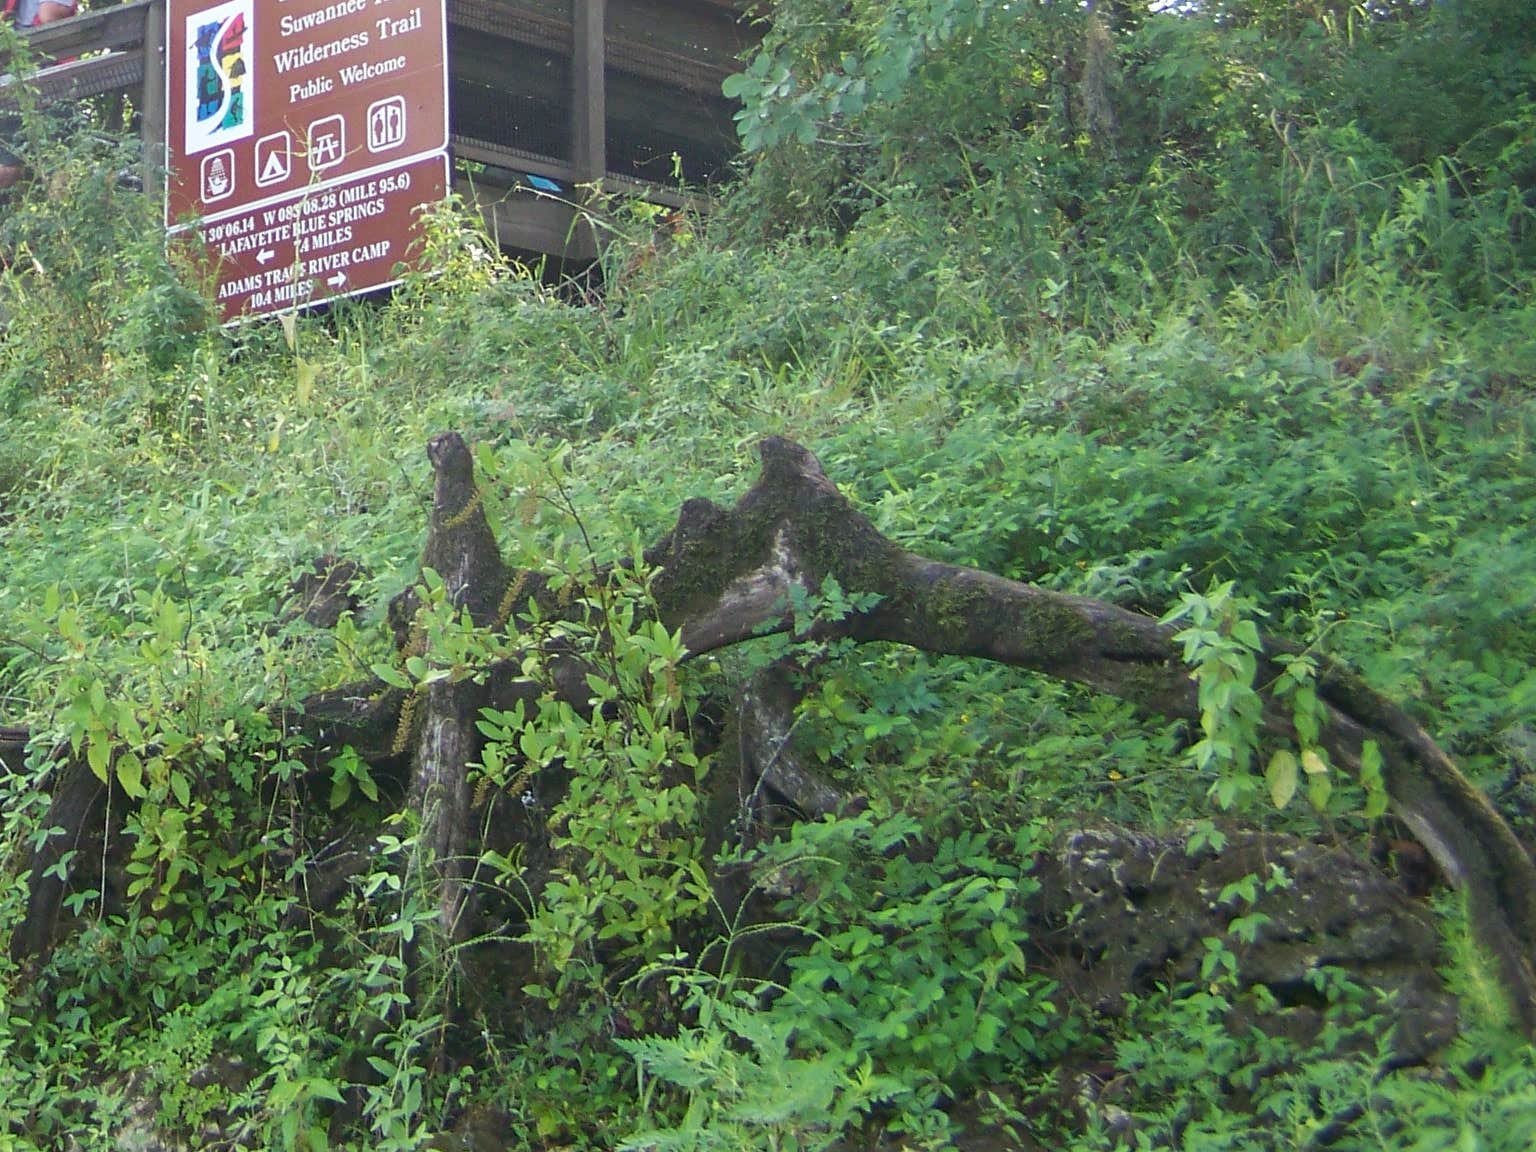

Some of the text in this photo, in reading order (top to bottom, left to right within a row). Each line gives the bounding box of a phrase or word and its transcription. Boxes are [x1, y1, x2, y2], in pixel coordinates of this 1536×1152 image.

[273, 7, 423, 74] Wilderness Trail
[289, 54, 407, 103] Public Welcome
[263, 208, 277, 226] W
[338, 180, 377, 208] (MILE
[378, 171, 411, 194] 95.6)
[221, 198, 386, 256] LAFAYETTE BLUE SPRINGS
[311, 225, 353, 250] MILES
[218, 274, 263, 299] ADAMS
[308, 249, 350, 276] RIVER
[351, 240, 391, 264] CAMP
[250, 286, 272, 308] 10.4
